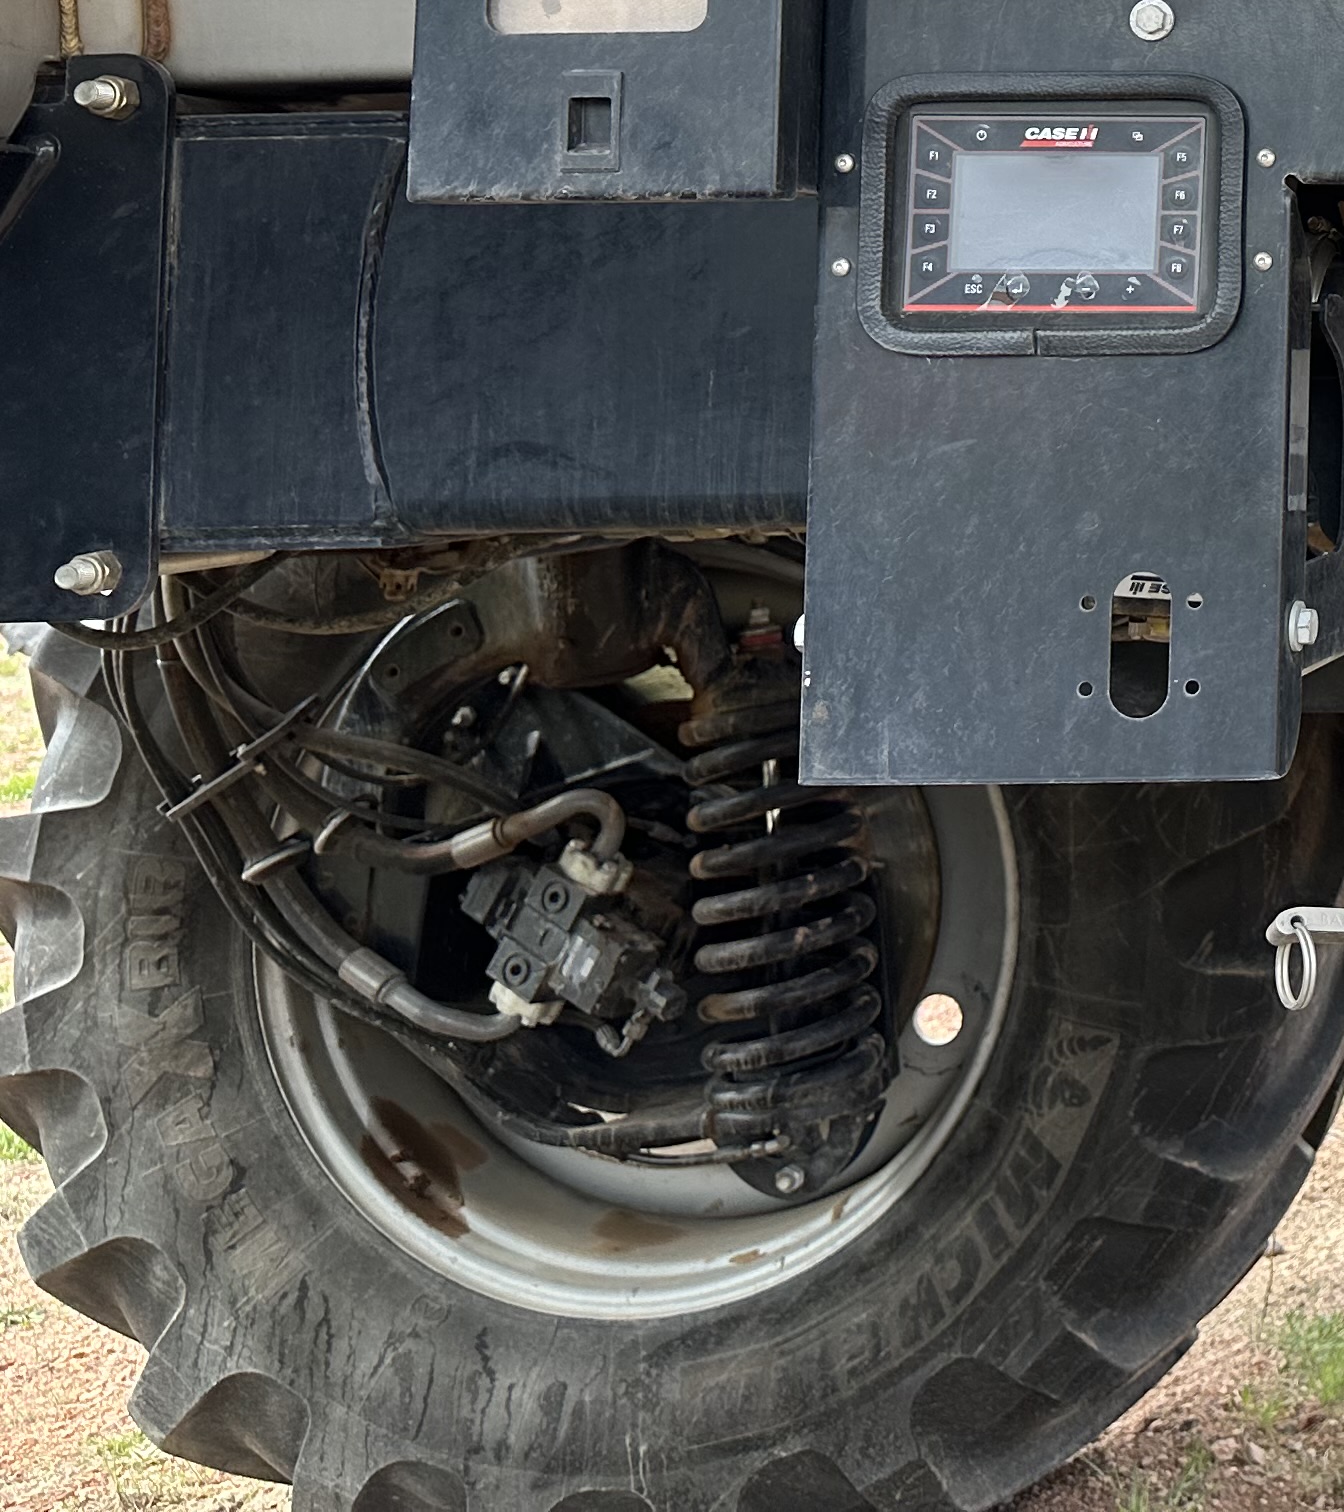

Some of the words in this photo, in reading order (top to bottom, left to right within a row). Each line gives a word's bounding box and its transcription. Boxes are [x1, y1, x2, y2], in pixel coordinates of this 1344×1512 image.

[1025, 126, 1079, 141] CASE
[929, 150, 938, 160] F1
[1176, 152, 1187, 162] F5
[926, 189, 937, 199] F2
[1175, 190, 1185, 200] F6
[925, 224, 936, 234] F3
[1173, 223, 1184, 235] F7
[922, 262, 933, 272] F4
[1171, 263, 1182, 273] F8
[964, 283, 982, 294] ESC
